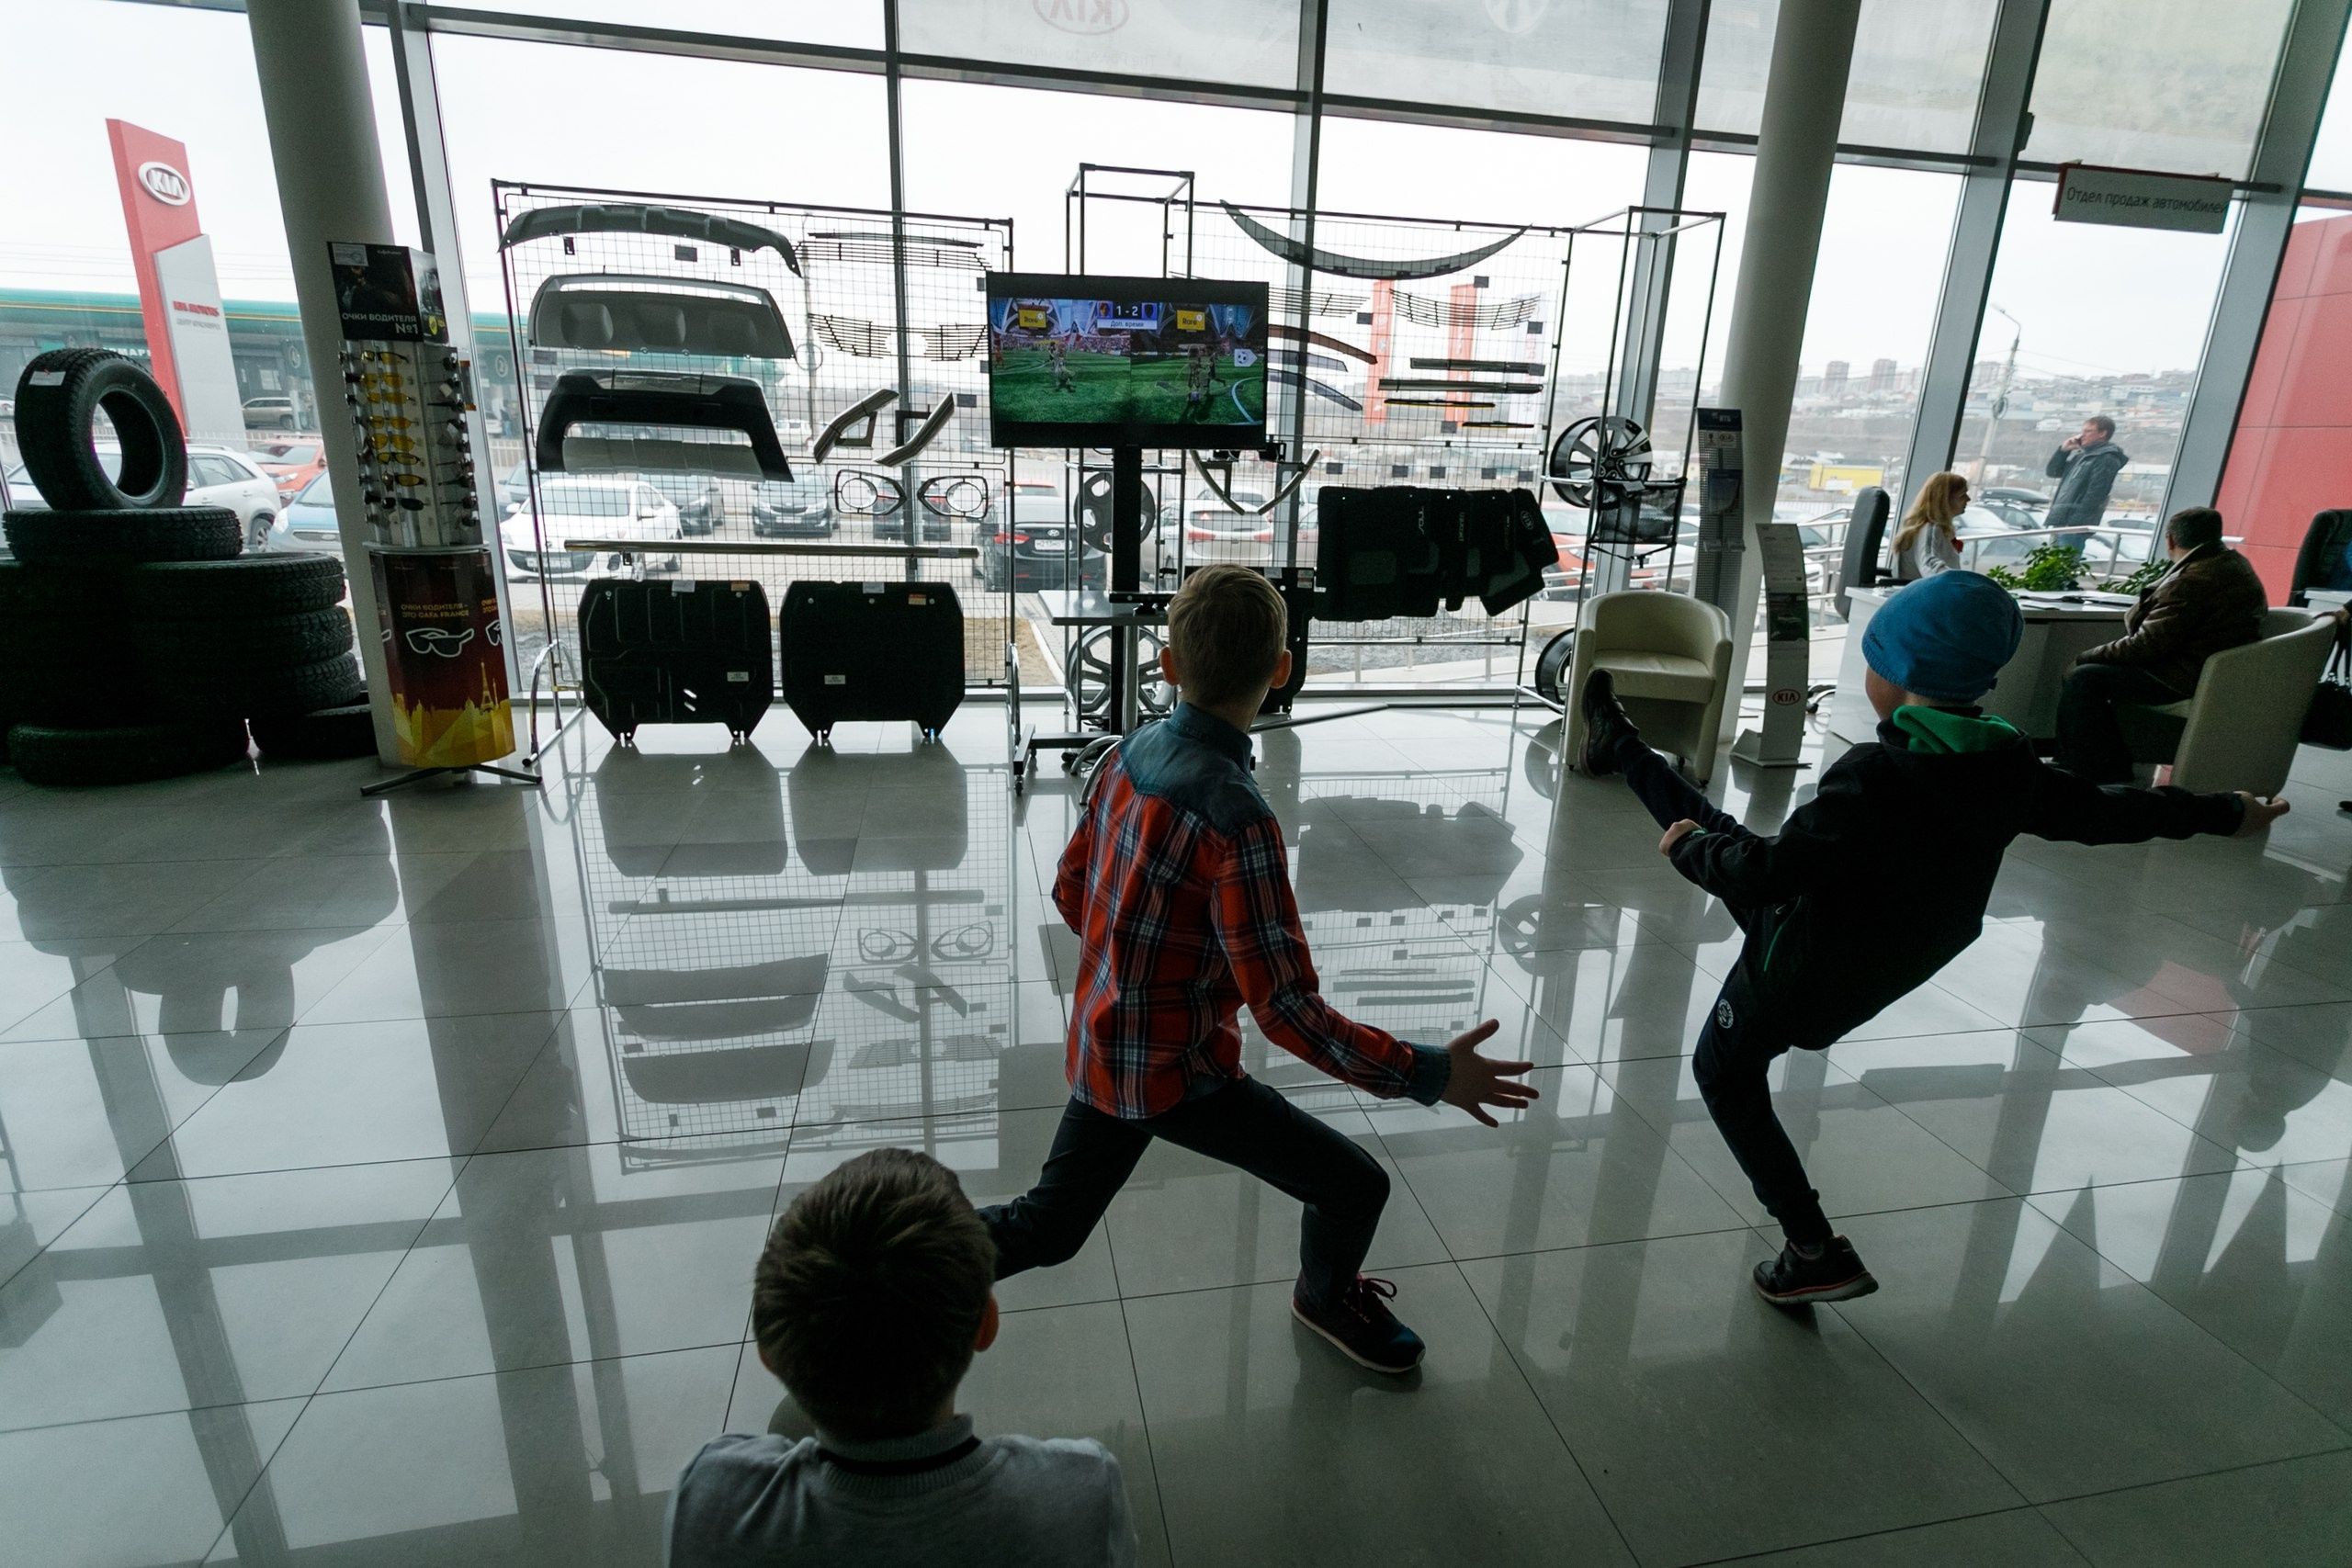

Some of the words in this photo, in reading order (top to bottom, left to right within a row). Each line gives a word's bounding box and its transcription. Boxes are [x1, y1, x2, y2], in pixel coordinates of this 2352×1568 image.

[145, 167, 186, 200] KIA
[2066, 186, 2103, 204] Отдел
[2105, 192, 2150, 208] продаж
[341, 312, 368, 321] ОЧКИ
[368, 313, 417, 322] ВОДИТЕЛЯ
[1115, 305, 1122, 316] 1
[1131, 305, 1138, 317] 2
[395, 322, 419, 334] №1
[1521, 511, 1533, 530] KIA
[1775, 691, 1798, 704] KIA
